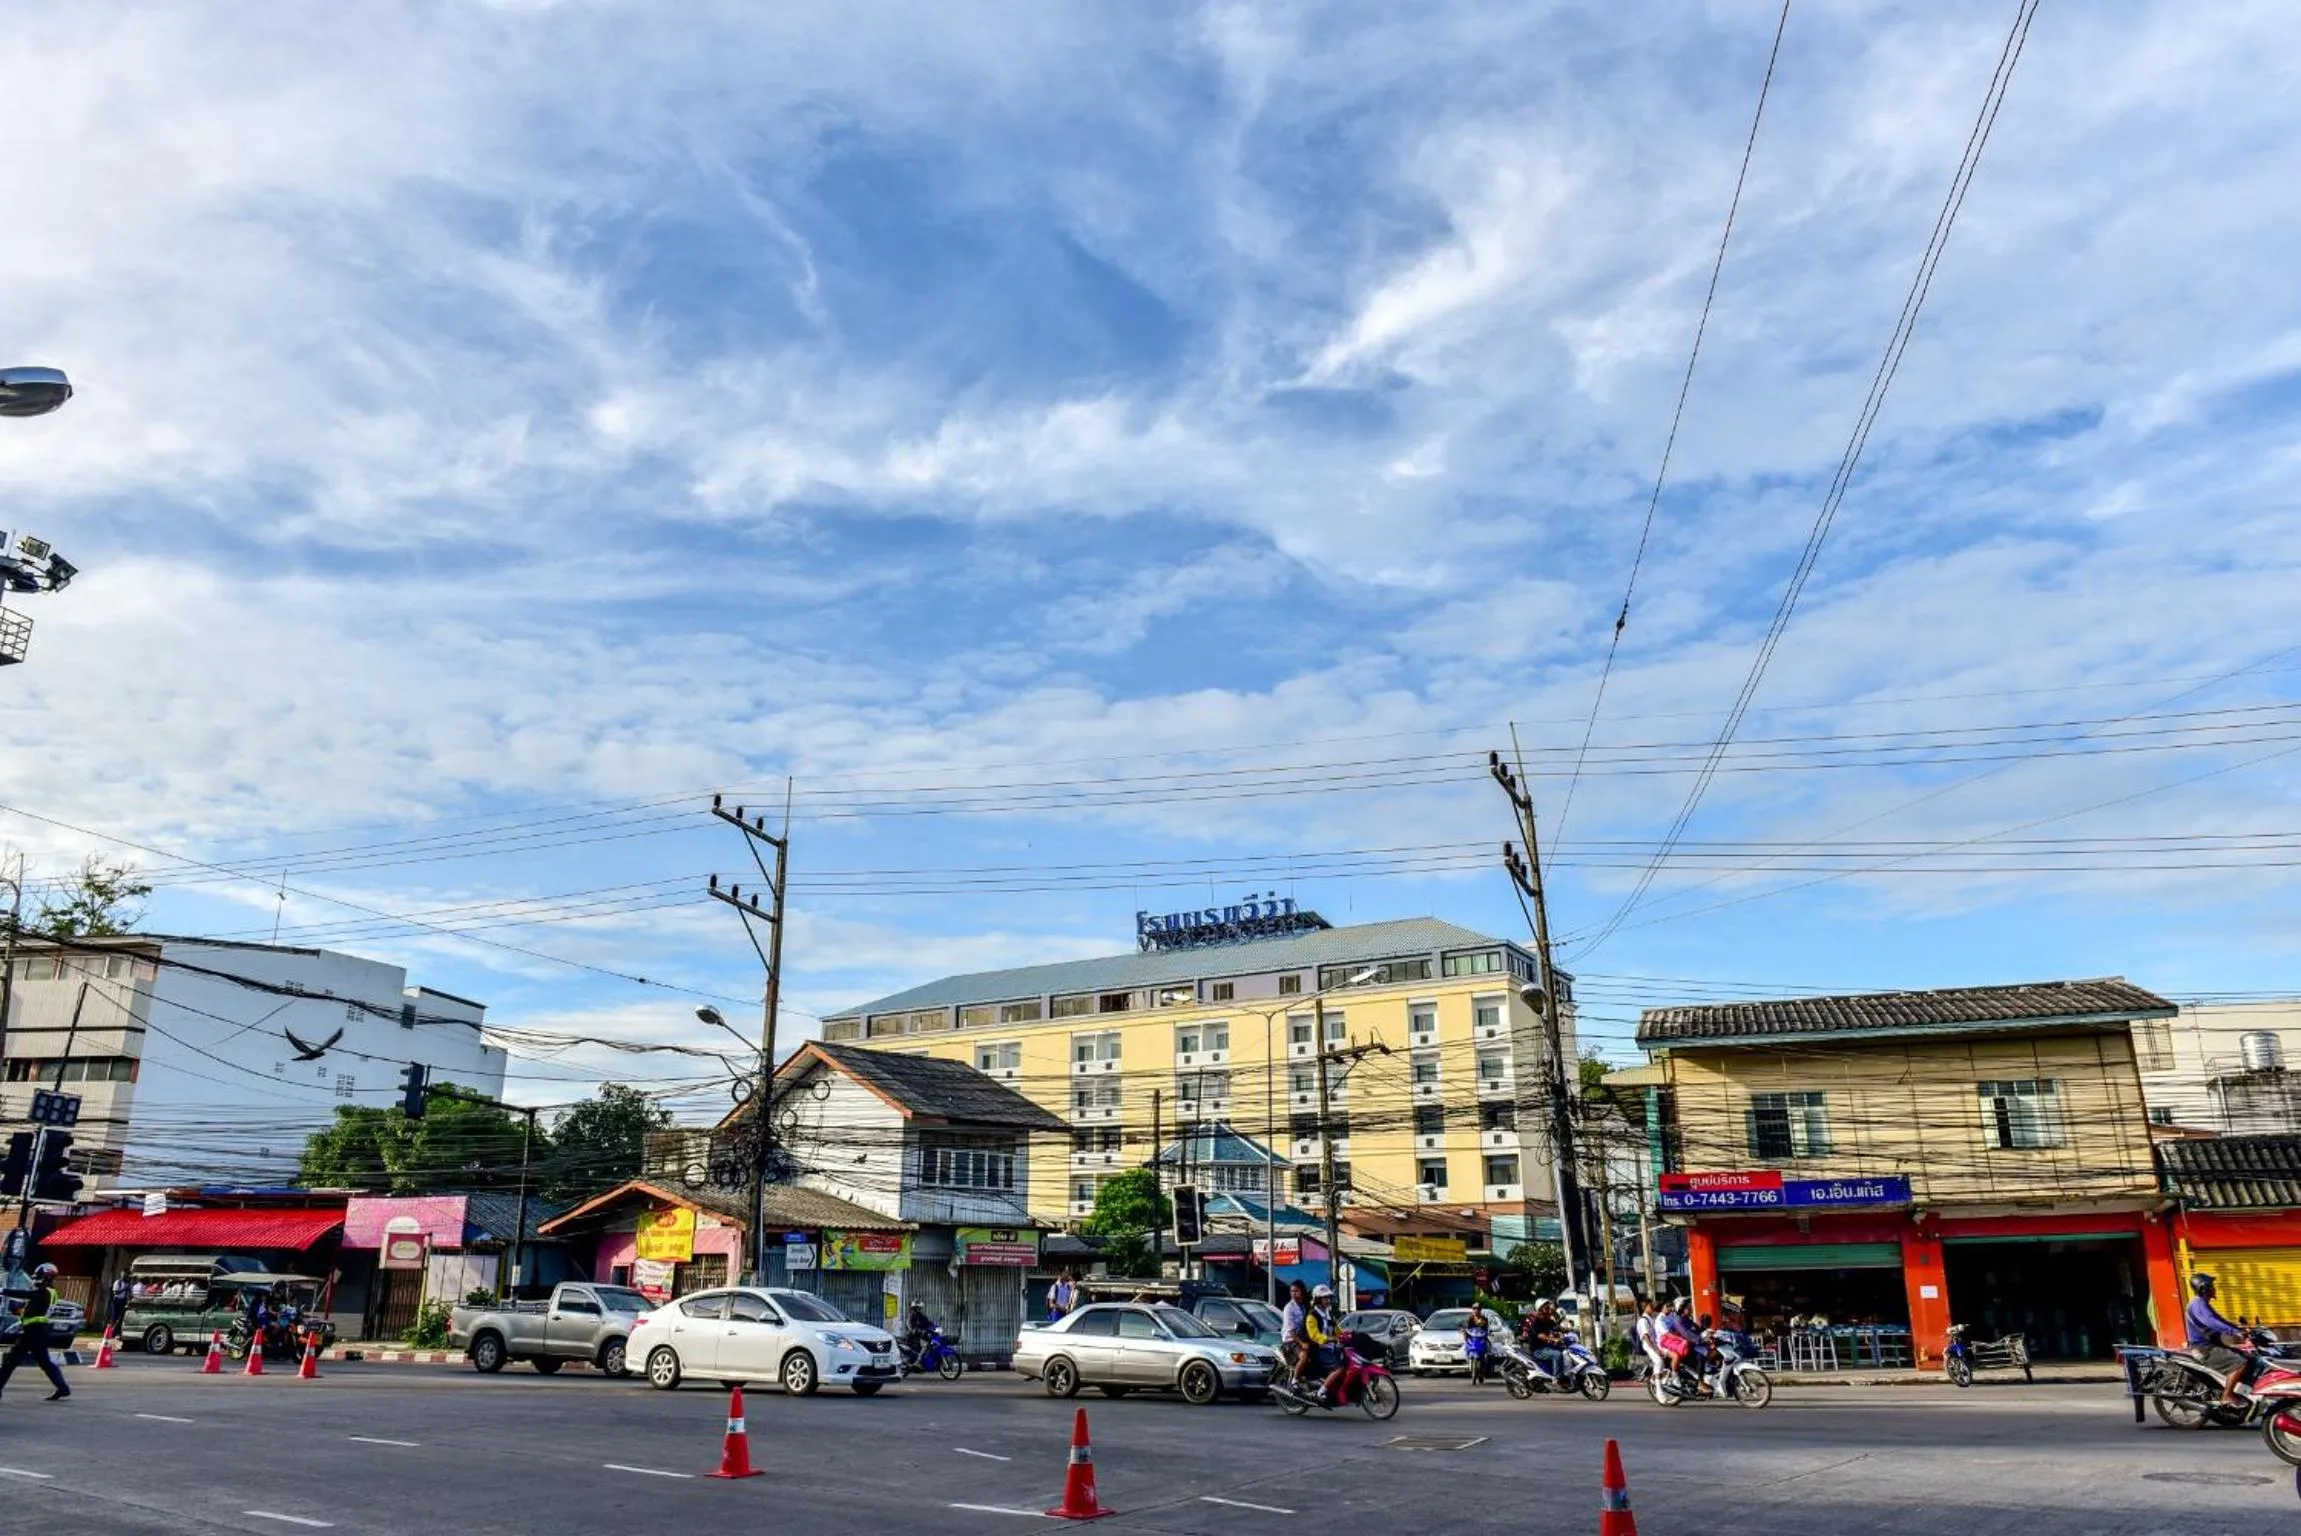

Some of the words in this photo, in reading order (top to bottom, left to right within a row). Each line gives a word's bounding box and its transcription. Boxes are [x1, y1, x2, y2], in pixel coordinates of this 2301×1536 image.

[1689, 1174, 1750, 1189] ศูนย์บริการ
[1684, 1190, 1777, 1206] 0-7443-7766
